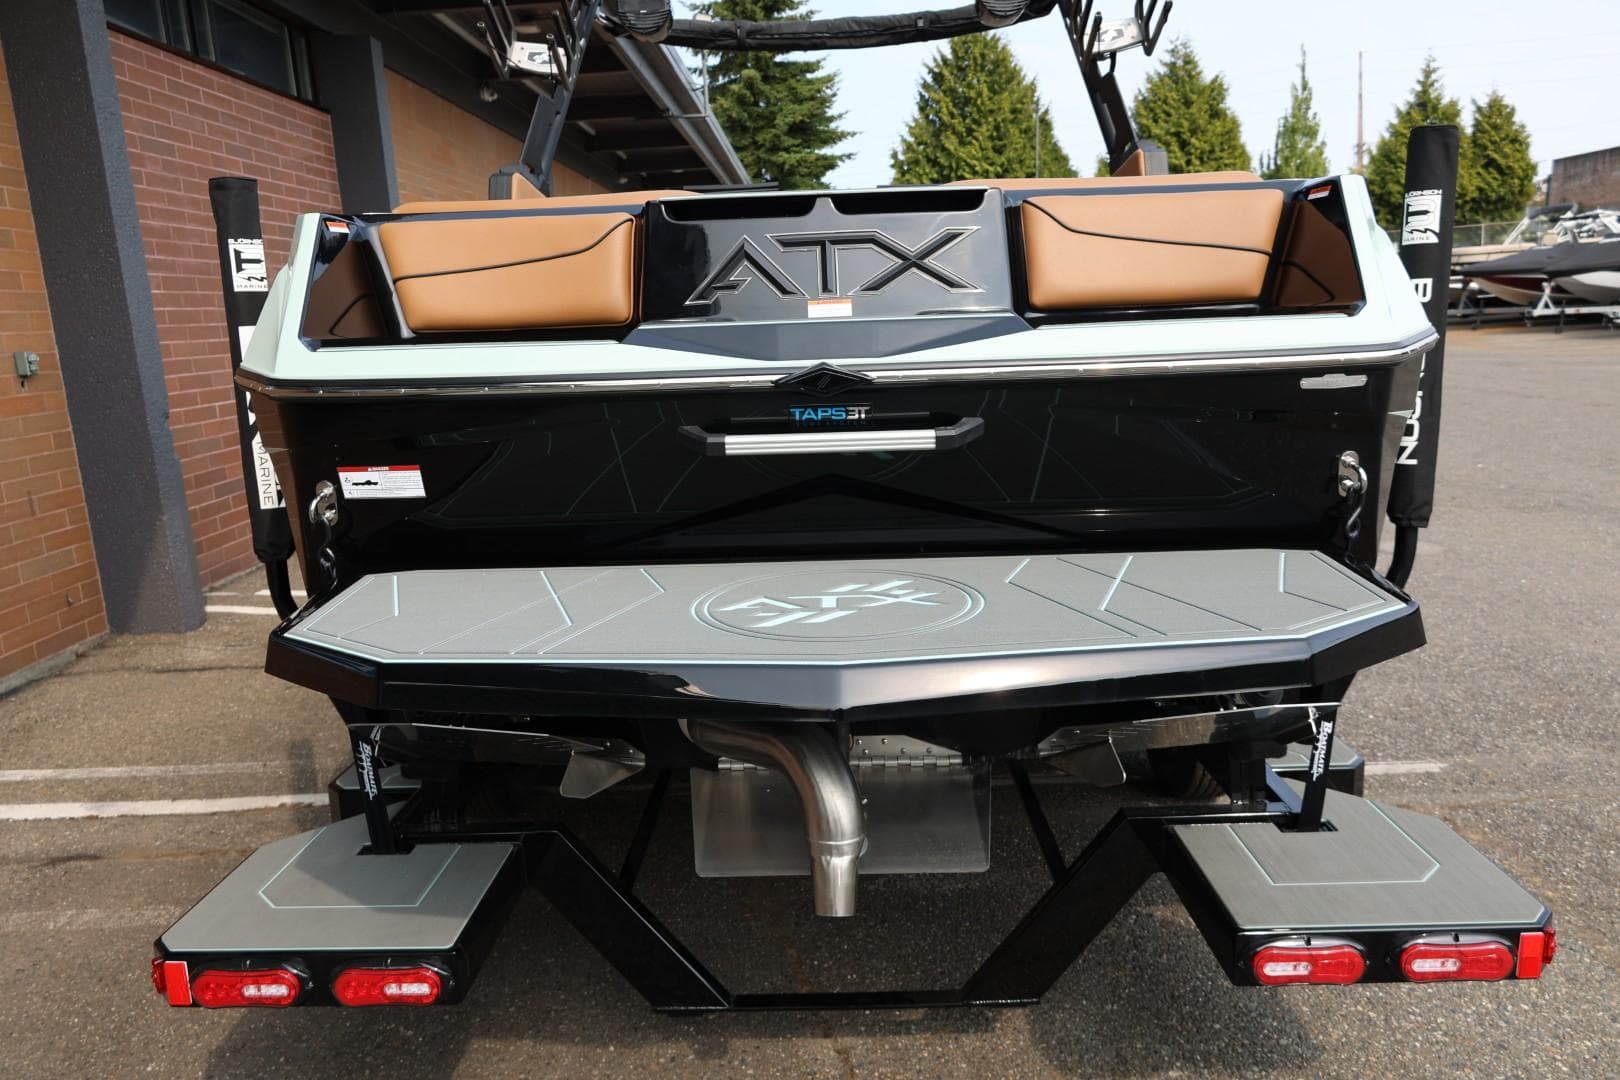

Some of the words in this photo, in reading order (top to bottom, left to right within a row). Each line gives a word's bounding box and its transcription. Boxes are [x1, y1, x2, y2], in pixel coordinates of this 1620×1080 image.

[684, 226, 986, 305] ATX
[789, 406, 871, 421] TAPS3T
[256, 441, 275, 506] MARINE
